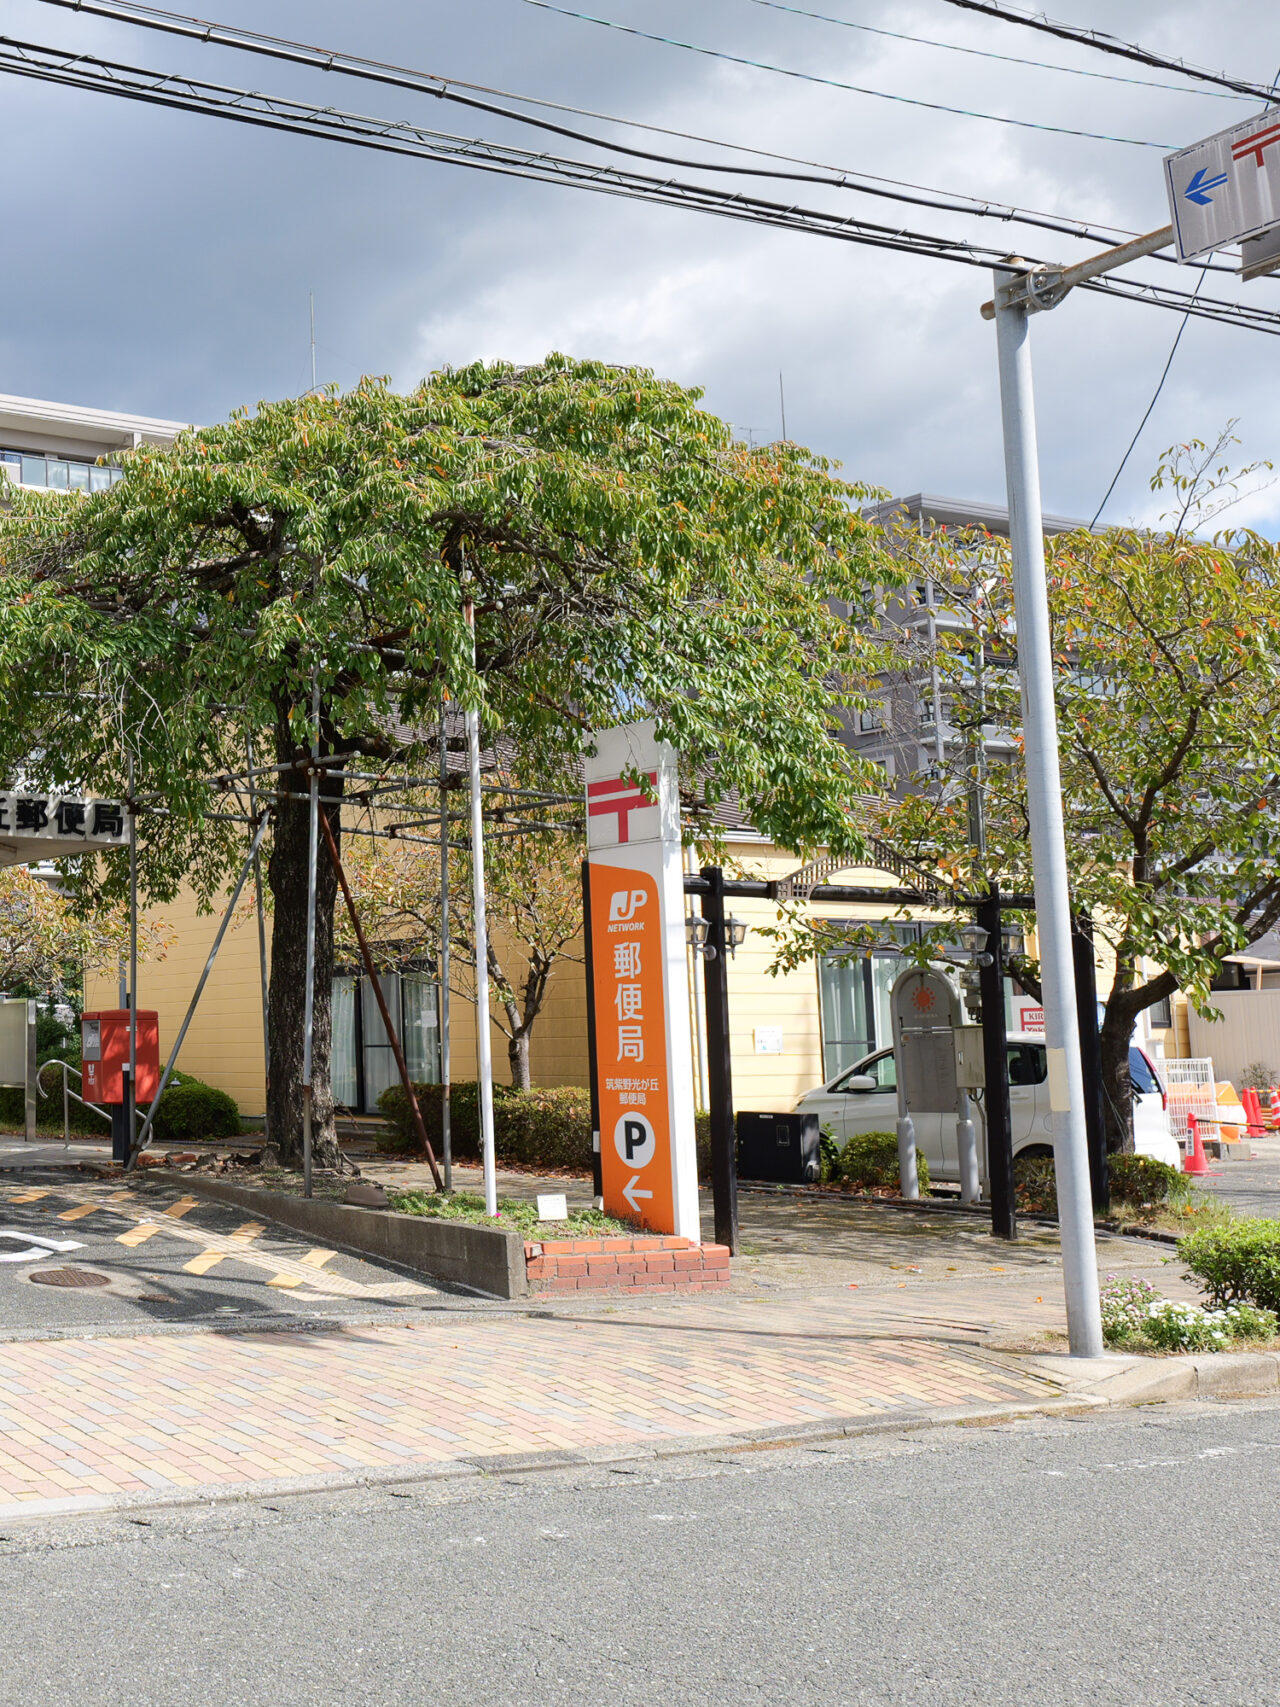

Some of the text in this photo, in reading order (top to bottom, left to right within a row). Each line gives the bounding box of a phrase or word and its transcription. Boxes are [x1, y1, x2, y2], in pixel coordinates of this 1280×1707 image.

[607, 921, 645, 932] NETWORK
[614, 941, 645, 1062] 郵便局
[1028, 1012, 1044, 1020] KIR
[605, 1078, 659, 1091] 筑紫野光が丘
[619, 1092, 647, 1105] 郵便局
[624, 1120, 647, 1160] P
